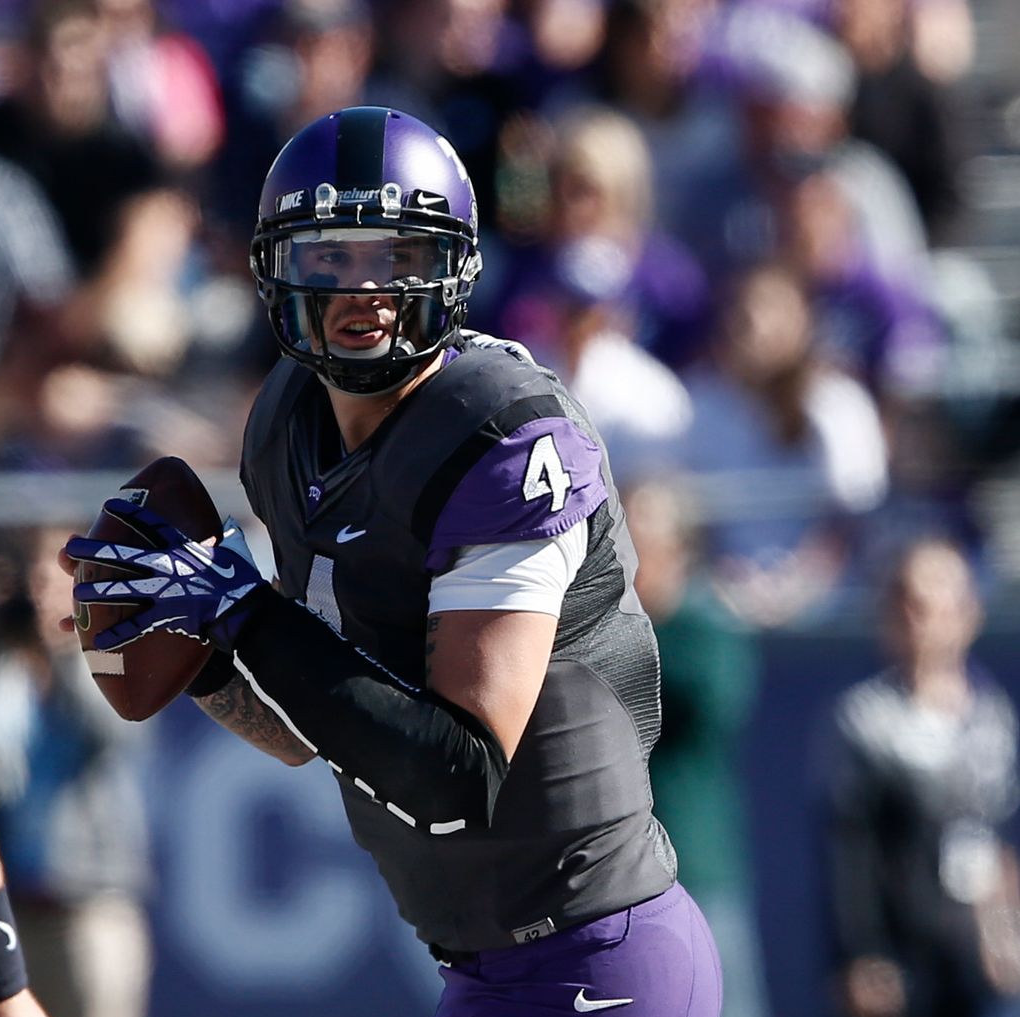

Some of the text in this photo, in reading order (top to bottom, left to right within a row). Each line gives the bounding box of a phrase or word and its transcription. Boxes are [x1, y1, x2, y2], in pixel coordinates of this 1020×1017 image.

[280, 189, 305, 213] NIKE
[523, 433, 572, 512] 4
[524, 929, 540, 942] 42
